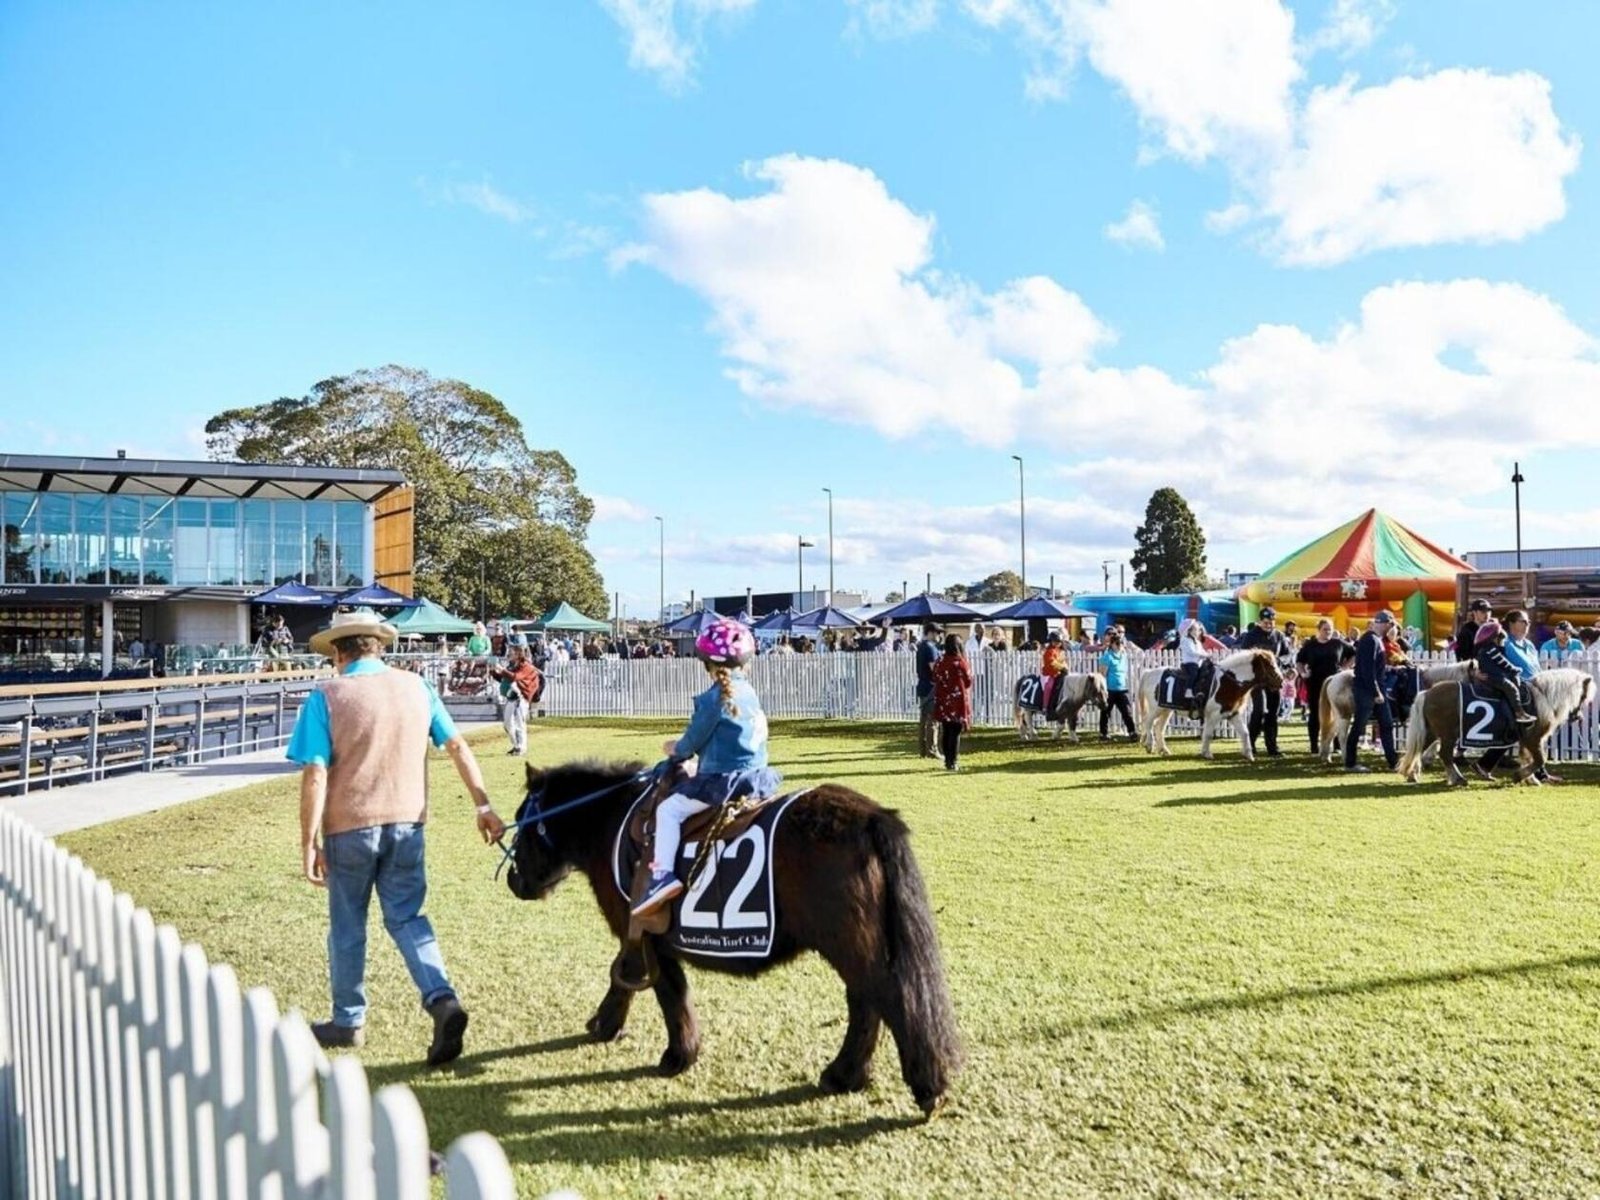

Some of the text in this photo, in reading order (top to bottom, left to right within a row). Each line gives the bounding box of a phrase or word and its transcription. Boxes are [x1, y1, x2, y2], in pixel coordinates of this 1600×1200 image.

[1020, 677, 1039, 704] 21
[1165, 675, 1175, 703] 1
[1466, 700, 1495, 740] 2
[680, 825, 768, 929] 22
[679, 933, 769, 946] Australian Turf Club
